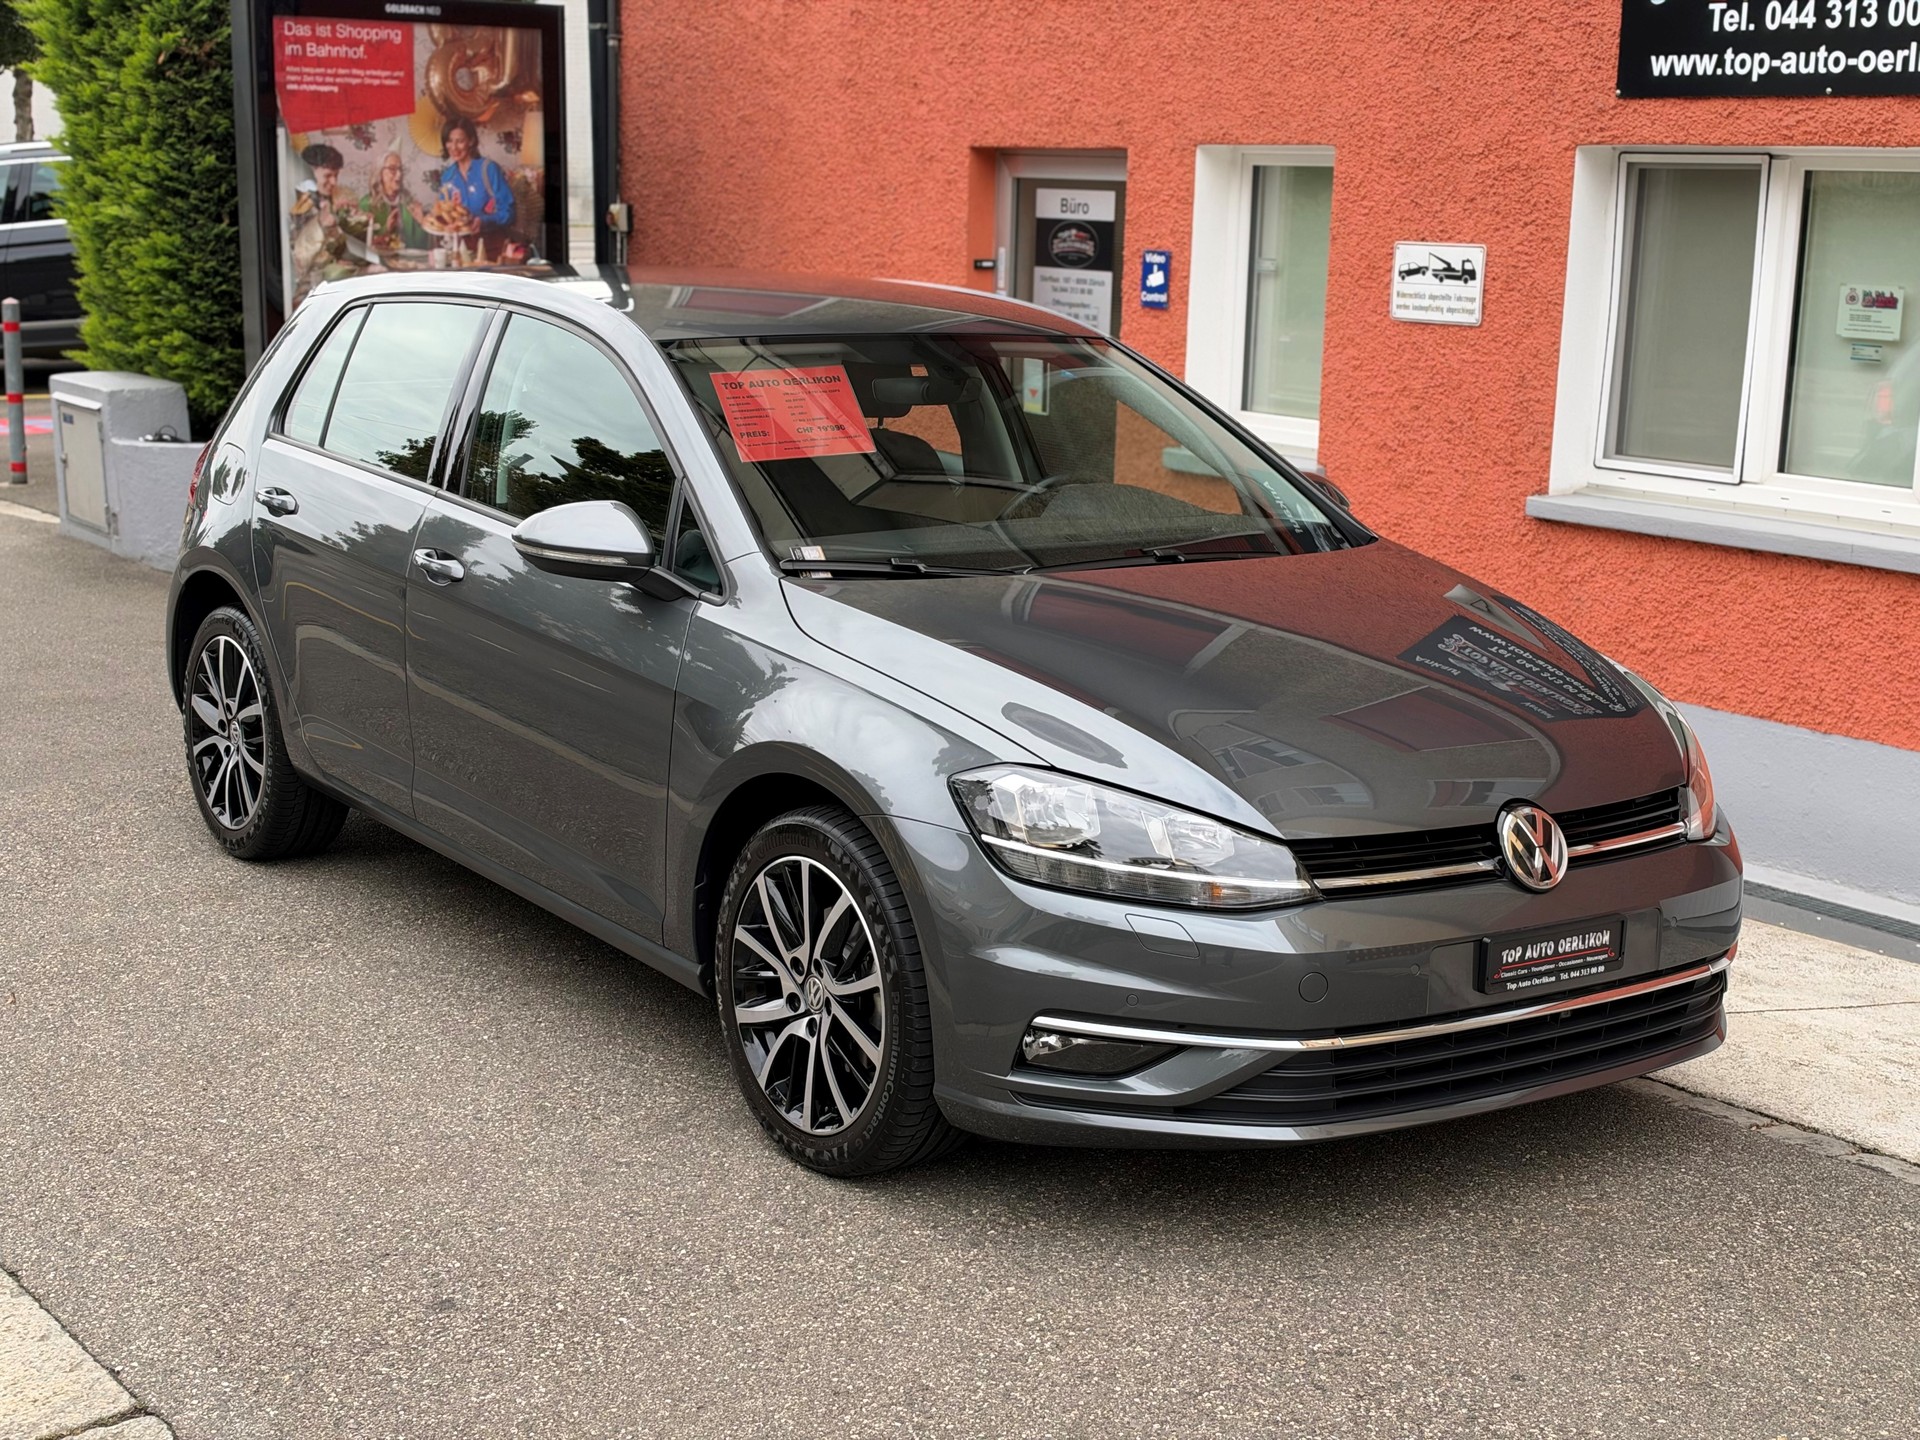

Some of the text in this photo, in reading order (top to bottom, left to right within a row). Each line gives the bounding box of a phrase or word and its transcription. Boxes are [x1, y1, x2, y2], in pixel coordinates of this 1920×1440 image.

[1708, 2, 1755, 32] Tel.
[1765, 0, 1816, 30] 044
[1825, 0, 1878, 28] 313
[284, 21, 402, 44] Das ist Shopping
[285, 41, 367, 59] im Bahnhof.
[1060, 197, 1090, 215] Büro
[1145, 253, 1166, 264] Video
[1141, 291, 1168, 303] Control
[721, 375, 842, 390] TOP AUTO OERLIKON
[740, 430, 770, 439] PREIS:
[796, 426, 815, 434] CHF
[1501, 930, 1611, 964] TOP AUTO OERLIKON
[1506, 982, 1517, 990] Top
[1518, 980, 1531, 988] Auto
[1532, 976, 1556, 985] Oerlikon
